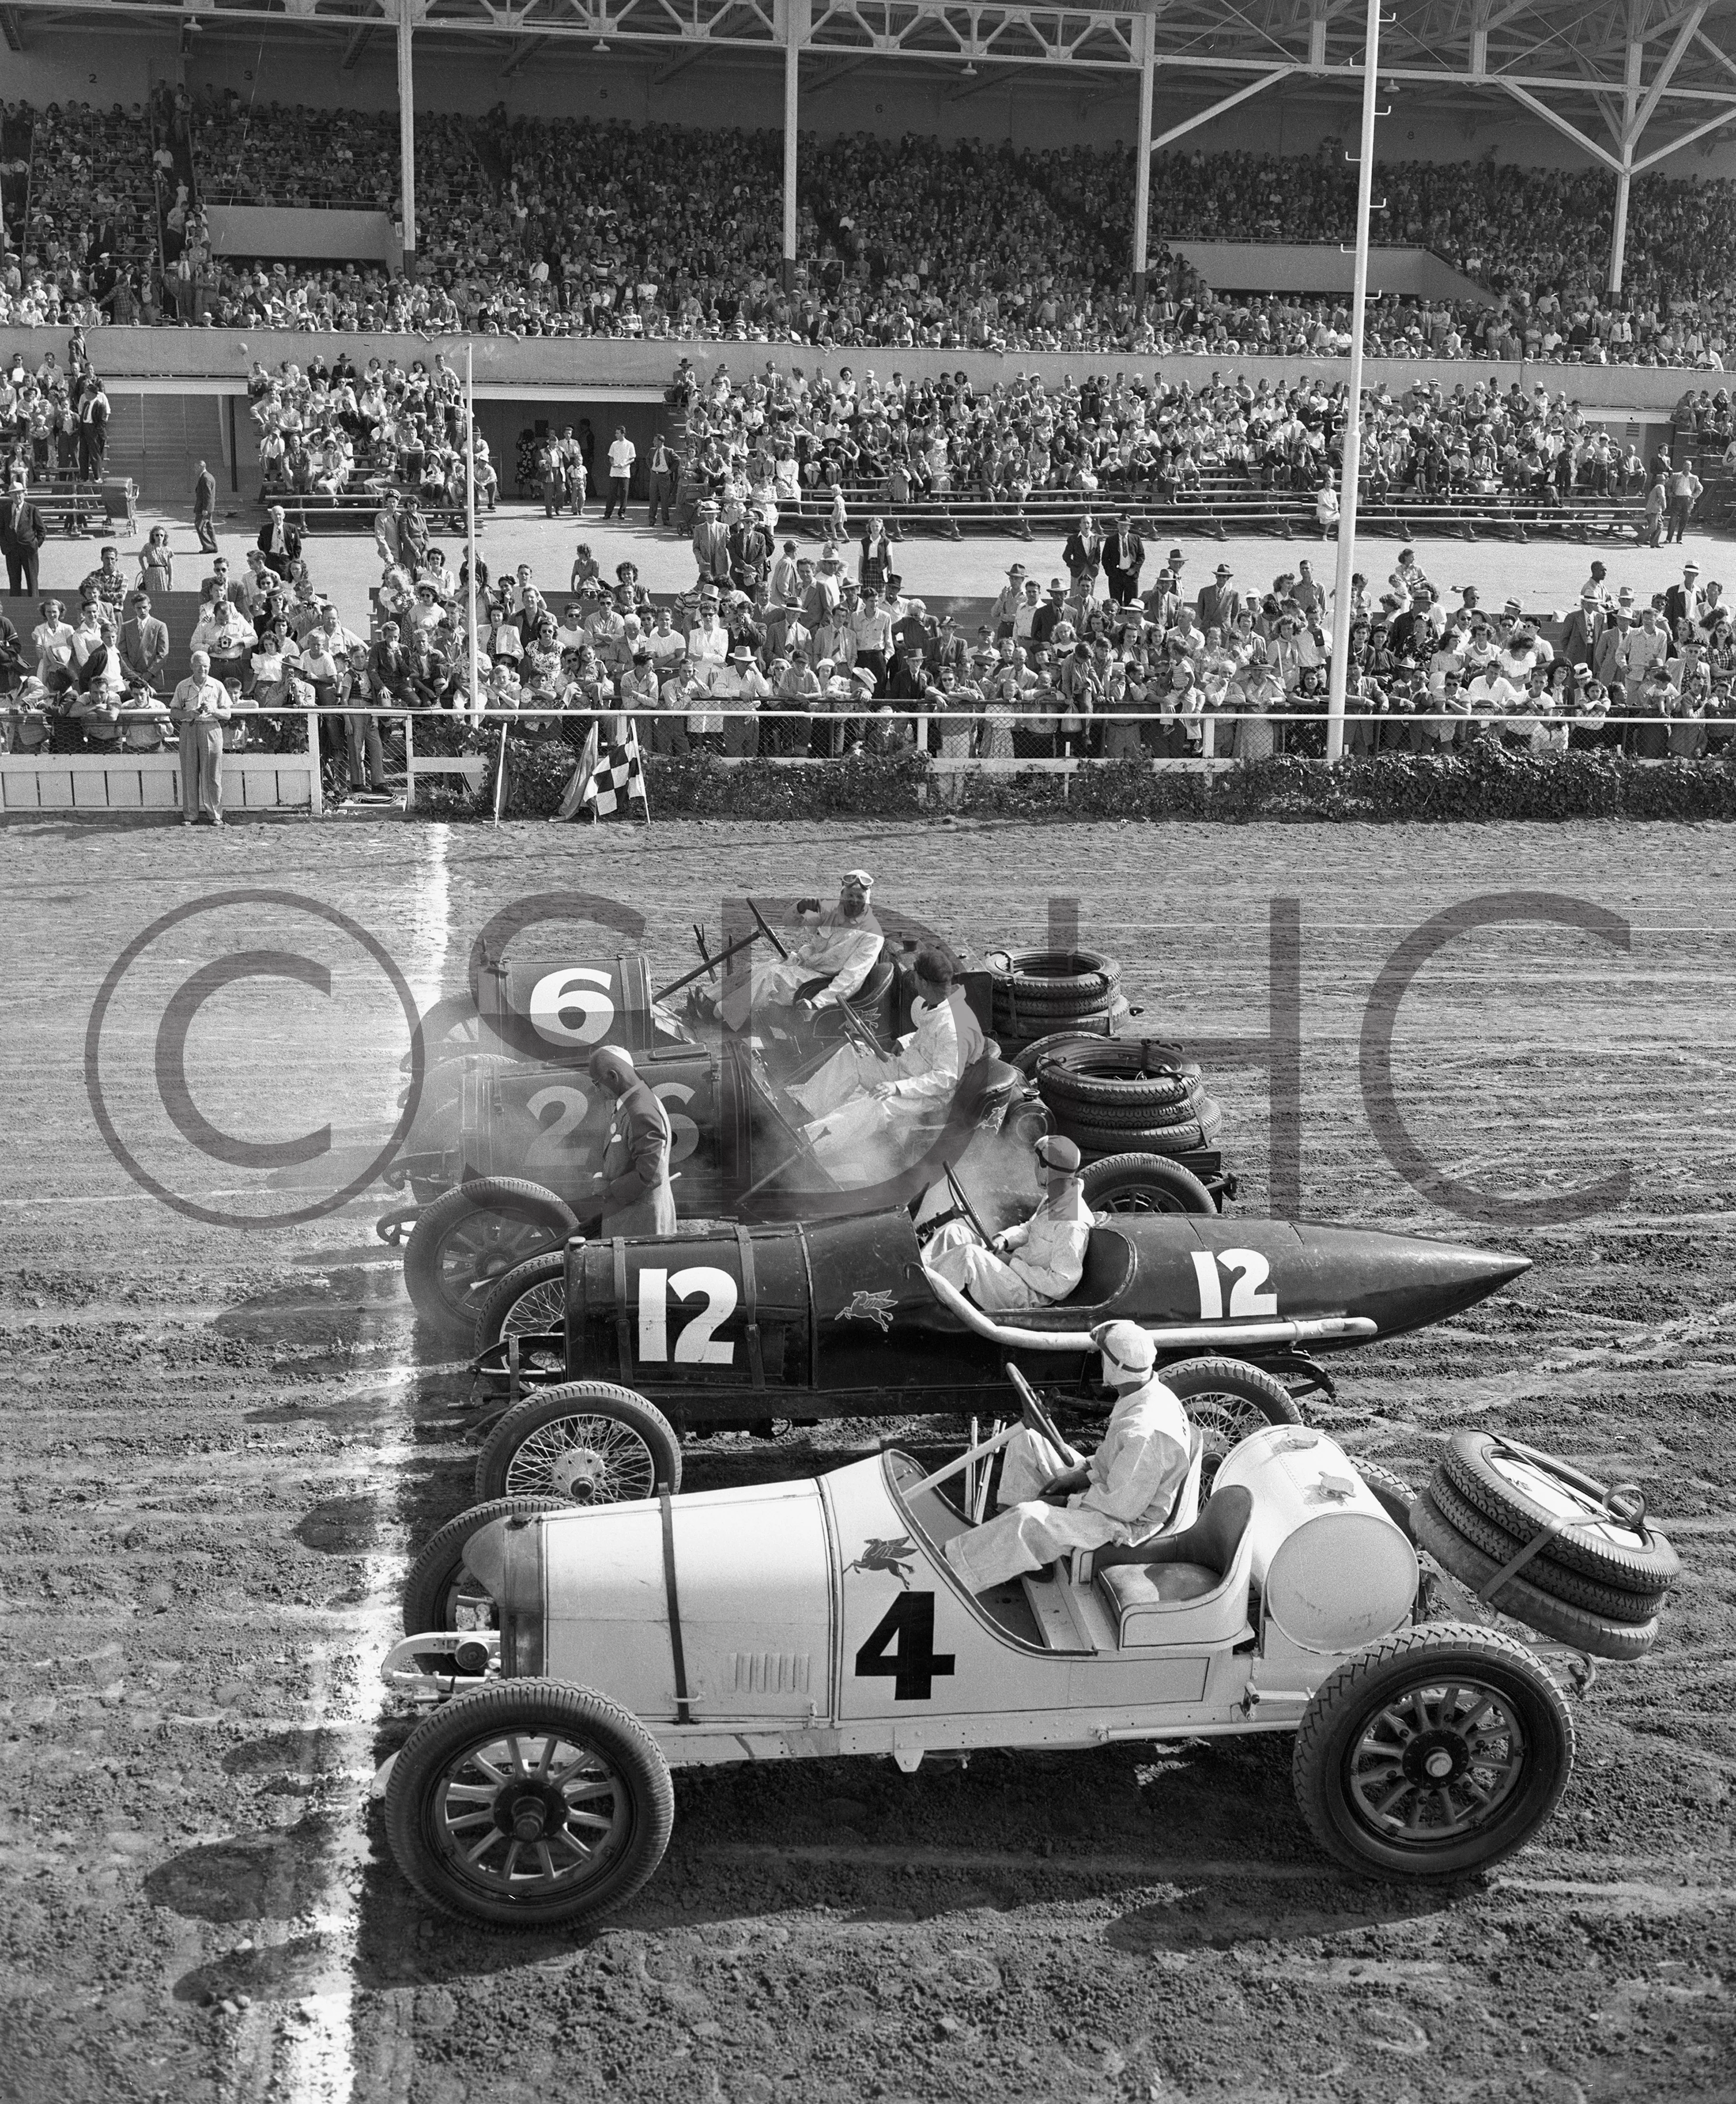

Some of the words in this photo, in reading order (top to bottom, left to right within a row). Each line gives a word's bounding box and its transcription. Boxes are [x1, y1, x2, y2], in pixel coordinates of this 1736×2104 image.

[89, 74, 97, 83] 2
[244, 70, 253, 80] 3
[600, 89, 608, 99] 5
[875, 104, 883, 113] 6
[530, 967, 615, 1047] 6
[1190, 1249, 1277, 1319] 12
[638, 1266, 738, 1364] 12
[854, 1591, 956, 1701] 4
